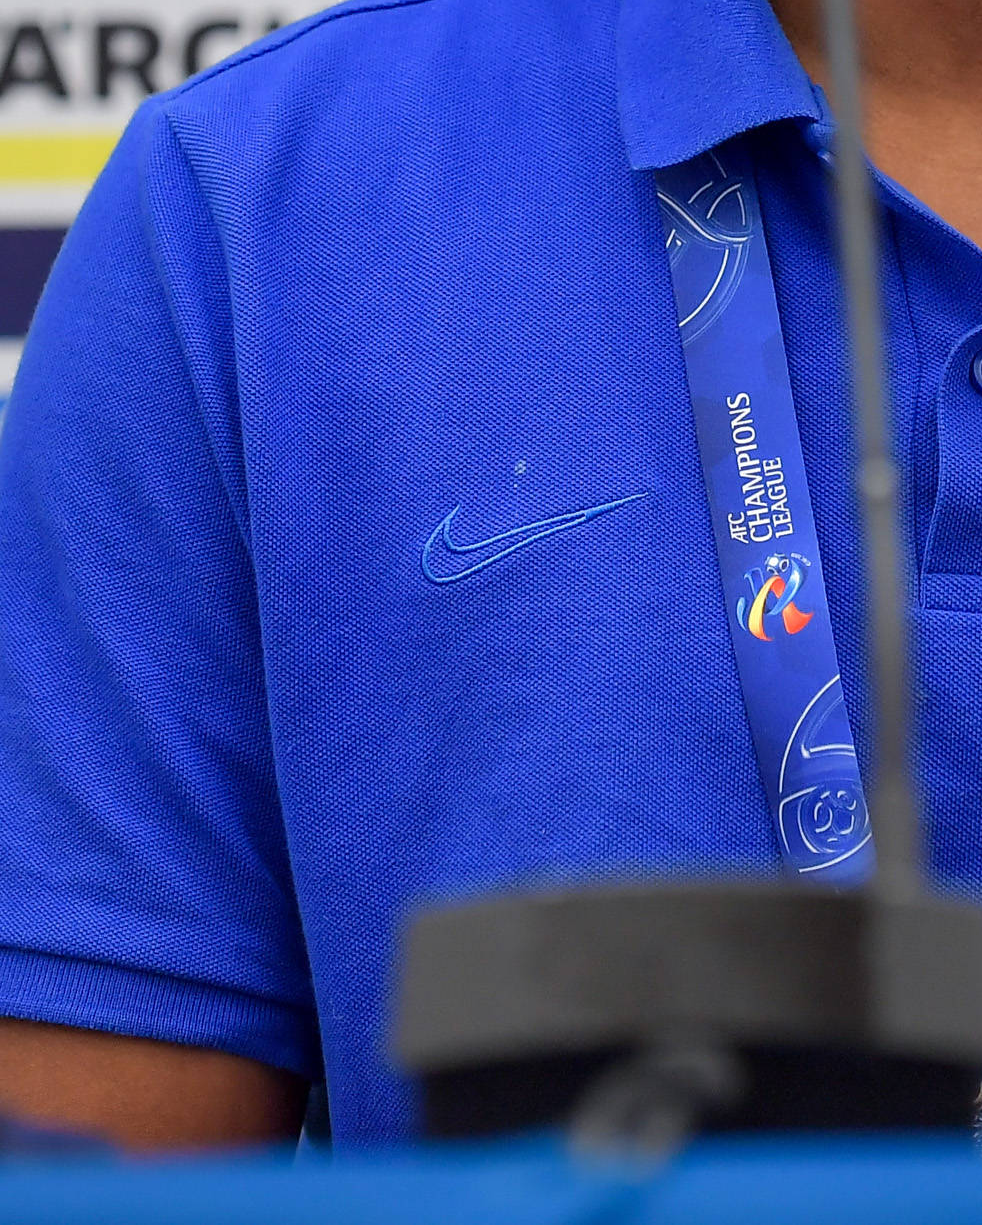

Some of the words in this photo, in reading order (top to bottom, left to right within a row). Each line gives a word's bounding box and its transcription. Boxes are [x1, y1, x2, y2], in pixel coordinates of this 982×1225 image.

[726, 392, 773, 543] CHAMPIONS
[762, 457, 794, 539] LEAGUE
[727, 511, 750, 544] AFC
